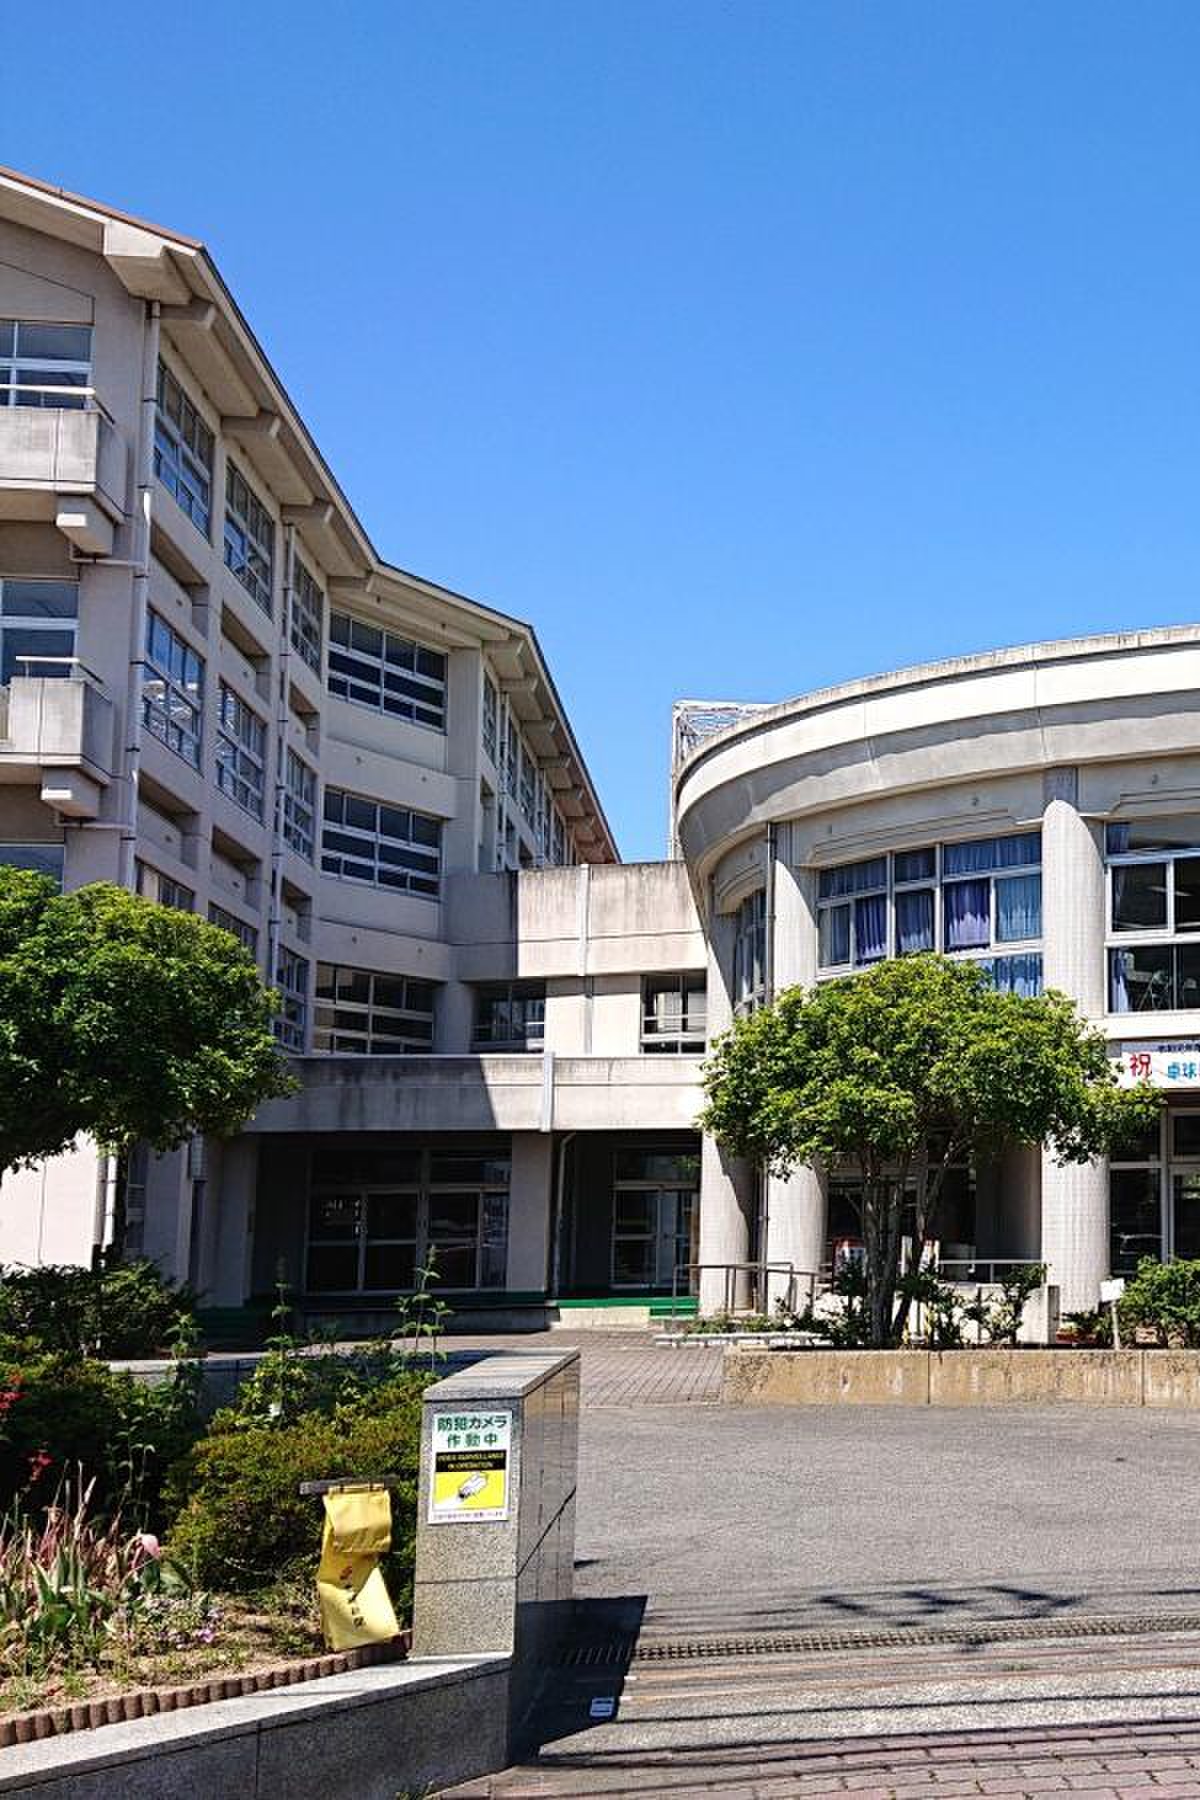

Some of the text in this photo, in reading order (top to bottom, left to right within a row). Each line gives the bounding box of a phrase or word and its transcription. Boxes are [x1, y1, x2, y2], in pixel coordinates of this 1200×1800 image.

[1129, 1053, 1153, 1078] 祝
[437, 1415, 507, 1432] 防犯カメラ
[447, 1433, 498, 1448] 作動中
